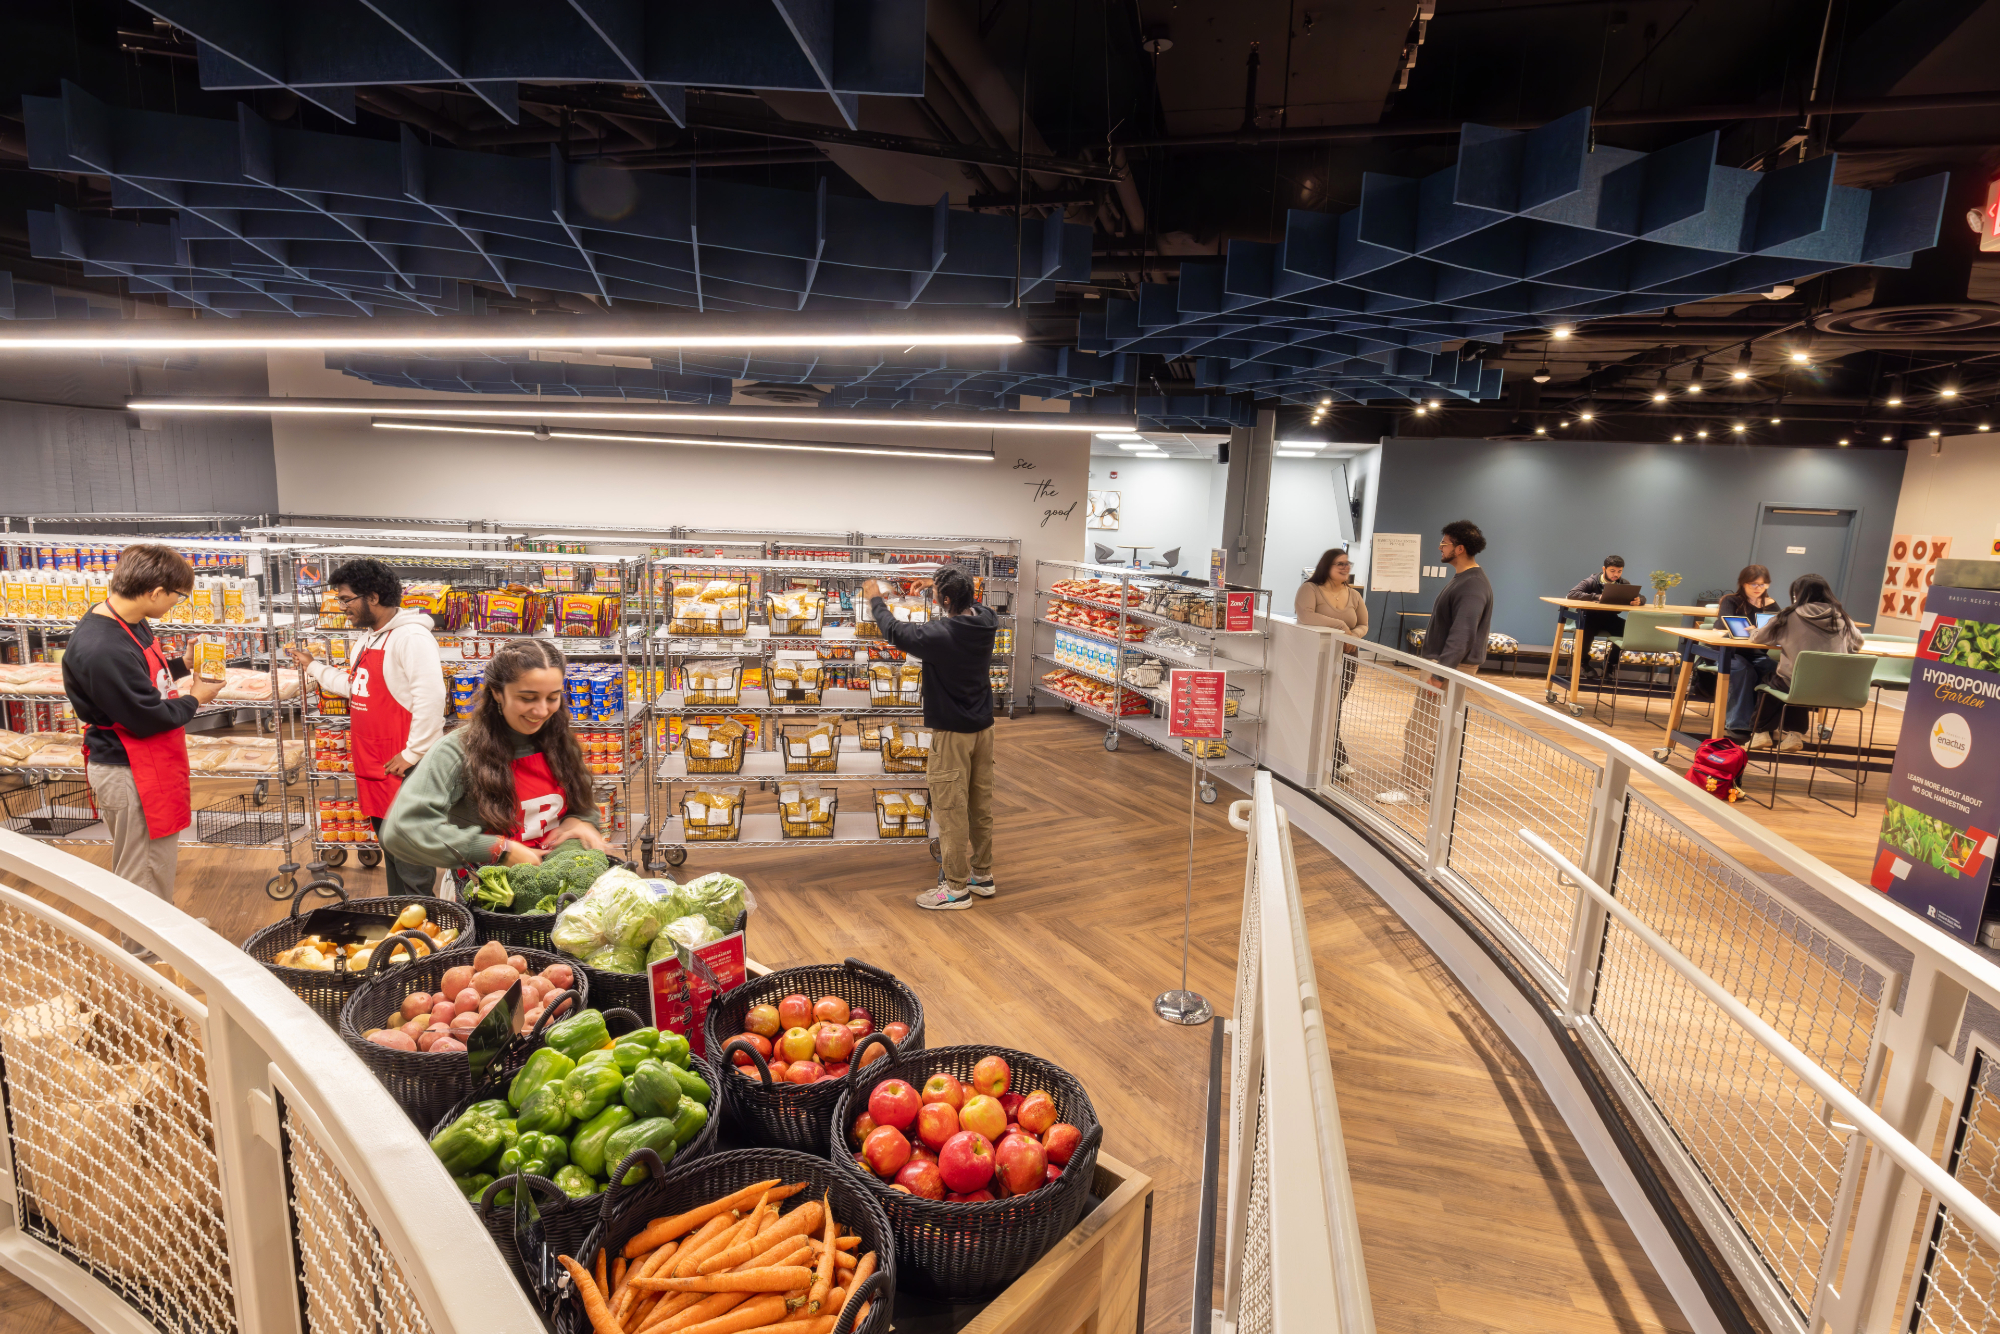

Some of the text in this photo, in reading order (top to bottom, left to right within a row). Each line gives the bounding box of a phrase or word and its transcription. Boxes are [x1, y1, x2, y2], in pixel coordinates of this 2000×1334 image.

[1012, 458, 1036, 470] see
[1024, 478, 1060, 502] the
[1040, 501, 1078, 528] good
[1240, 596, 1251, 613] 1
[1934, 683, 1985, 709] Garden
[1937, 736, 1965, 751] enactus
[1907, 773, 1983, 807] LEARN MORE ABOUT ABOUT
[1912, 785, 1970, 814] NO SOIL HARVESTING
[521, 794, 564, 842] R
[1927, 904, 1936, 918] R
[666, 970, 681, 980] Zone
[667, 992, 682, 1002] Zone
[680, 982, 690, 1003] 2
[670, 1015, 684, 1025] Zone
[682, 1005, 692, 1025] 3
